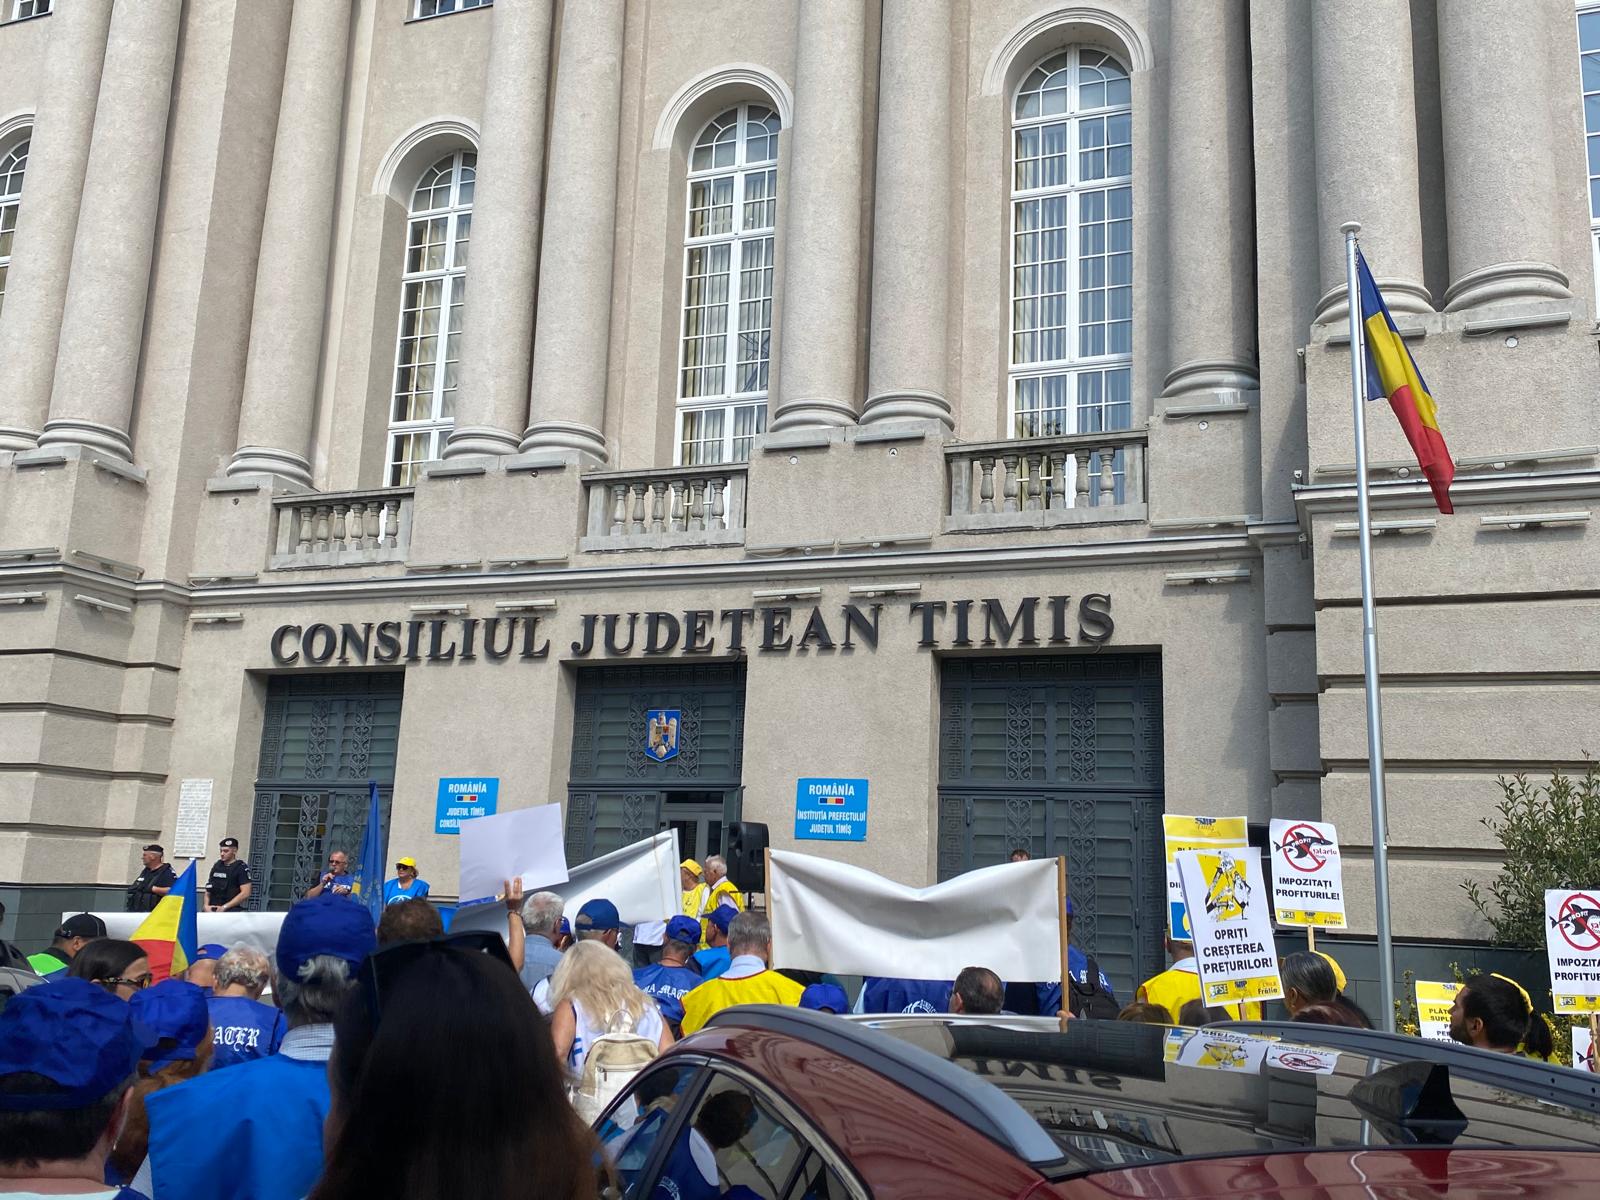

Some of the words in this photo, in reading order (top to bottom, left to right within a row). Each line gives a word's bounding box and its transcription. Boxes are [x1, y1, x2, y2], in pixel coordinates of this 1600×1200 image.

[270, 616, 550, 664] CONSILIUL
[808, 783, 855, 796] ROMÂNIA
[1279, 876, 1332, 890] IMPOZITAȚI
[1276, 888, 1340, 901] PROFITURILE!
[1214, 927, 1248, 941] OPRIȚI
[1203, 942, 1265, 959] CREȘTEREA
[1203, 957, 1273, 976] PREȚURILOR!
